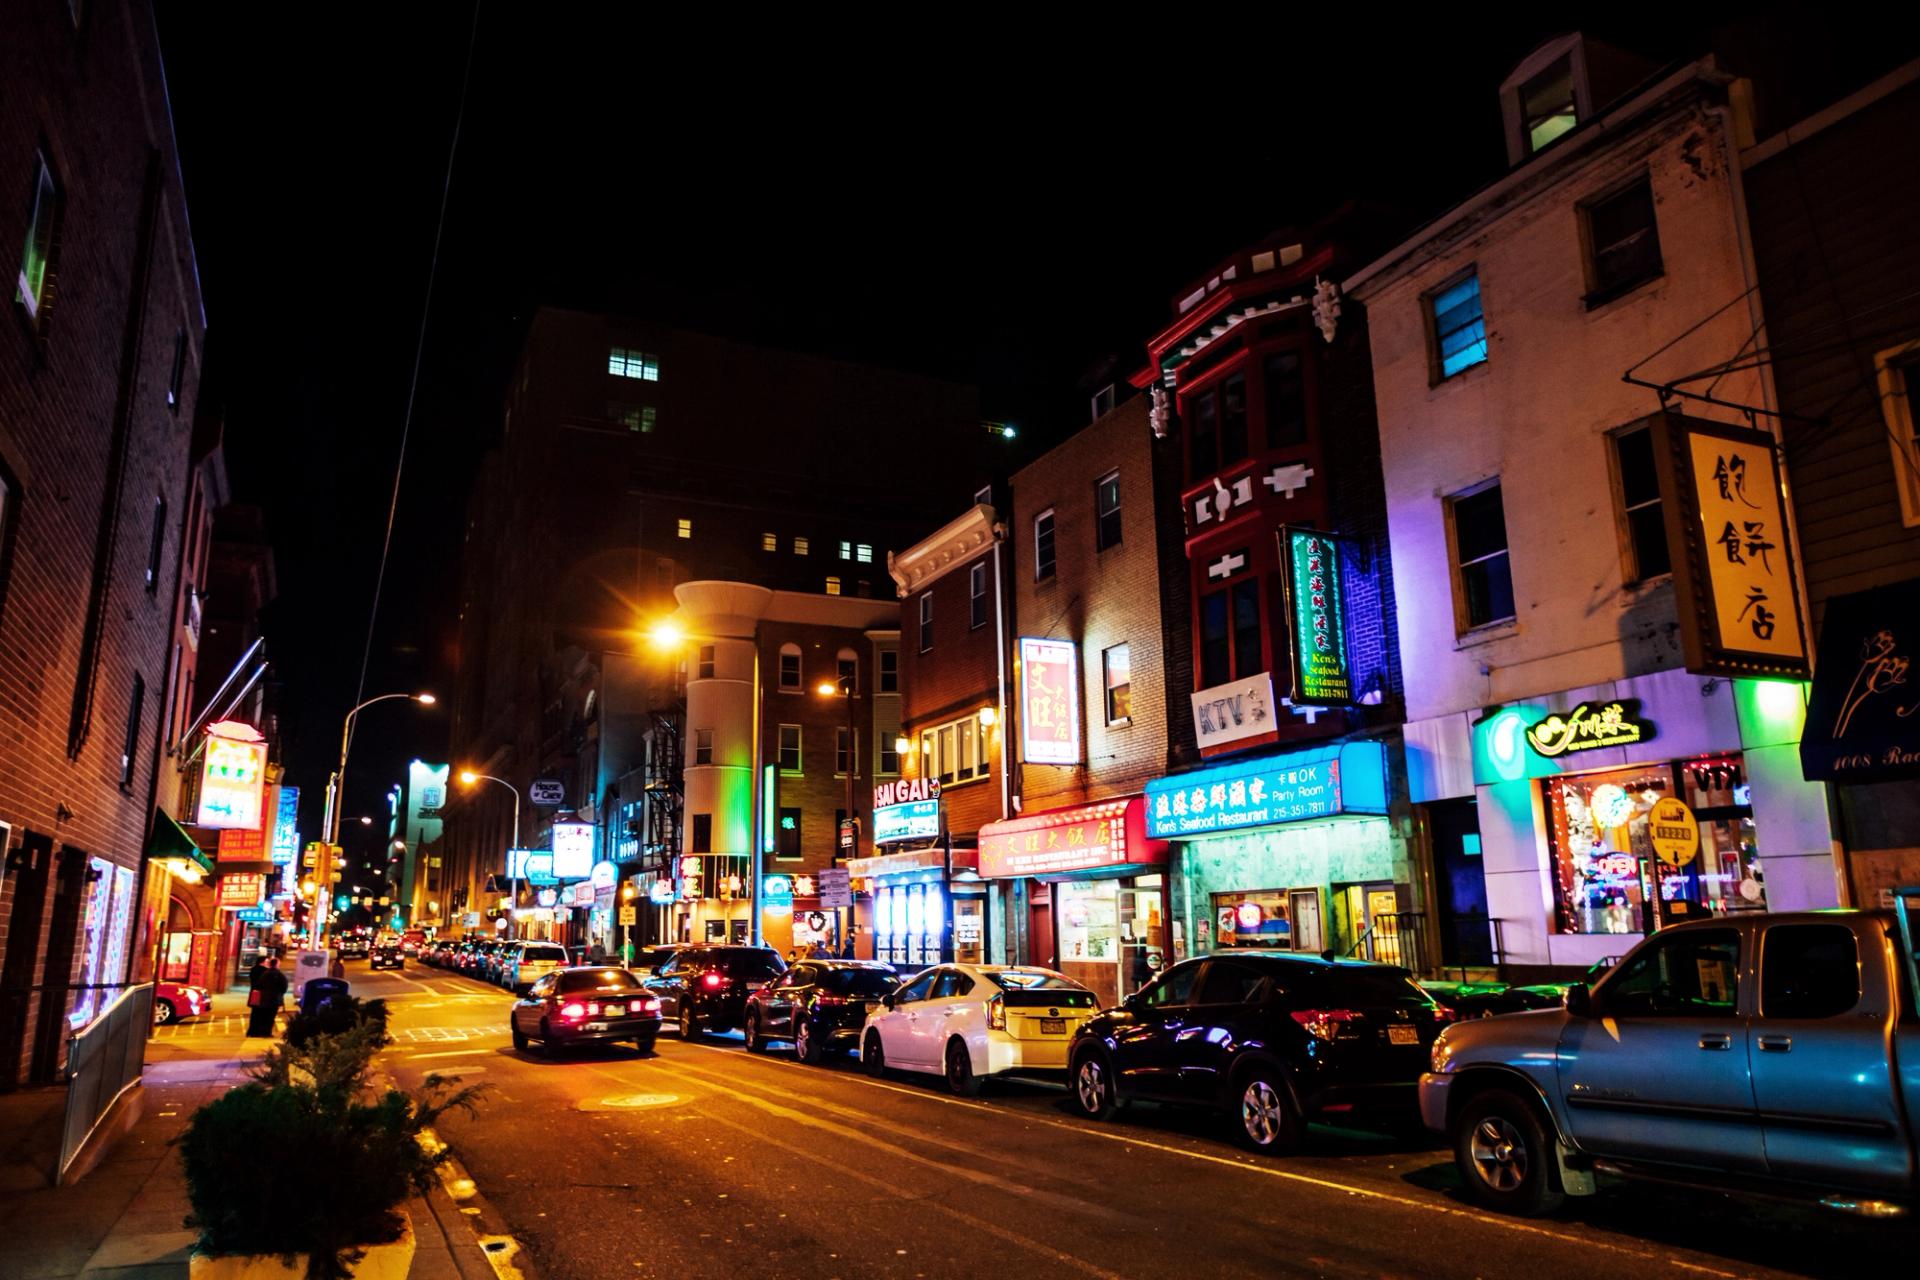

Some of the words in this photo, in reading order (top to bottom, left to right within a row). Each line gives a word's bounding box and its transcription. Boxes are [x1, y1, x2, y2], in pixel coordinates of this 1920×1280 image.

[1312, 653, 1336, 664] Ken's
[1310, 664, 1340, 677] Seafood
[1305, 675, 1347, 687] Restaurant
[1198, 694, 1243, 735] KTV
[896, 777, 929, 802] GAI
[1272, 789, 1295, 802] Party
[1299, 785, 1324, 797] Room
[1273, 801, 1325, 819] 215-351-7811
[1156, 820, 1177, 834] Ken's
[1180, 814, 1216, 832] Seafood
[1217, 807, 1269, 827] Restaurant
[1599, 858, 1637, 874] OPEN
